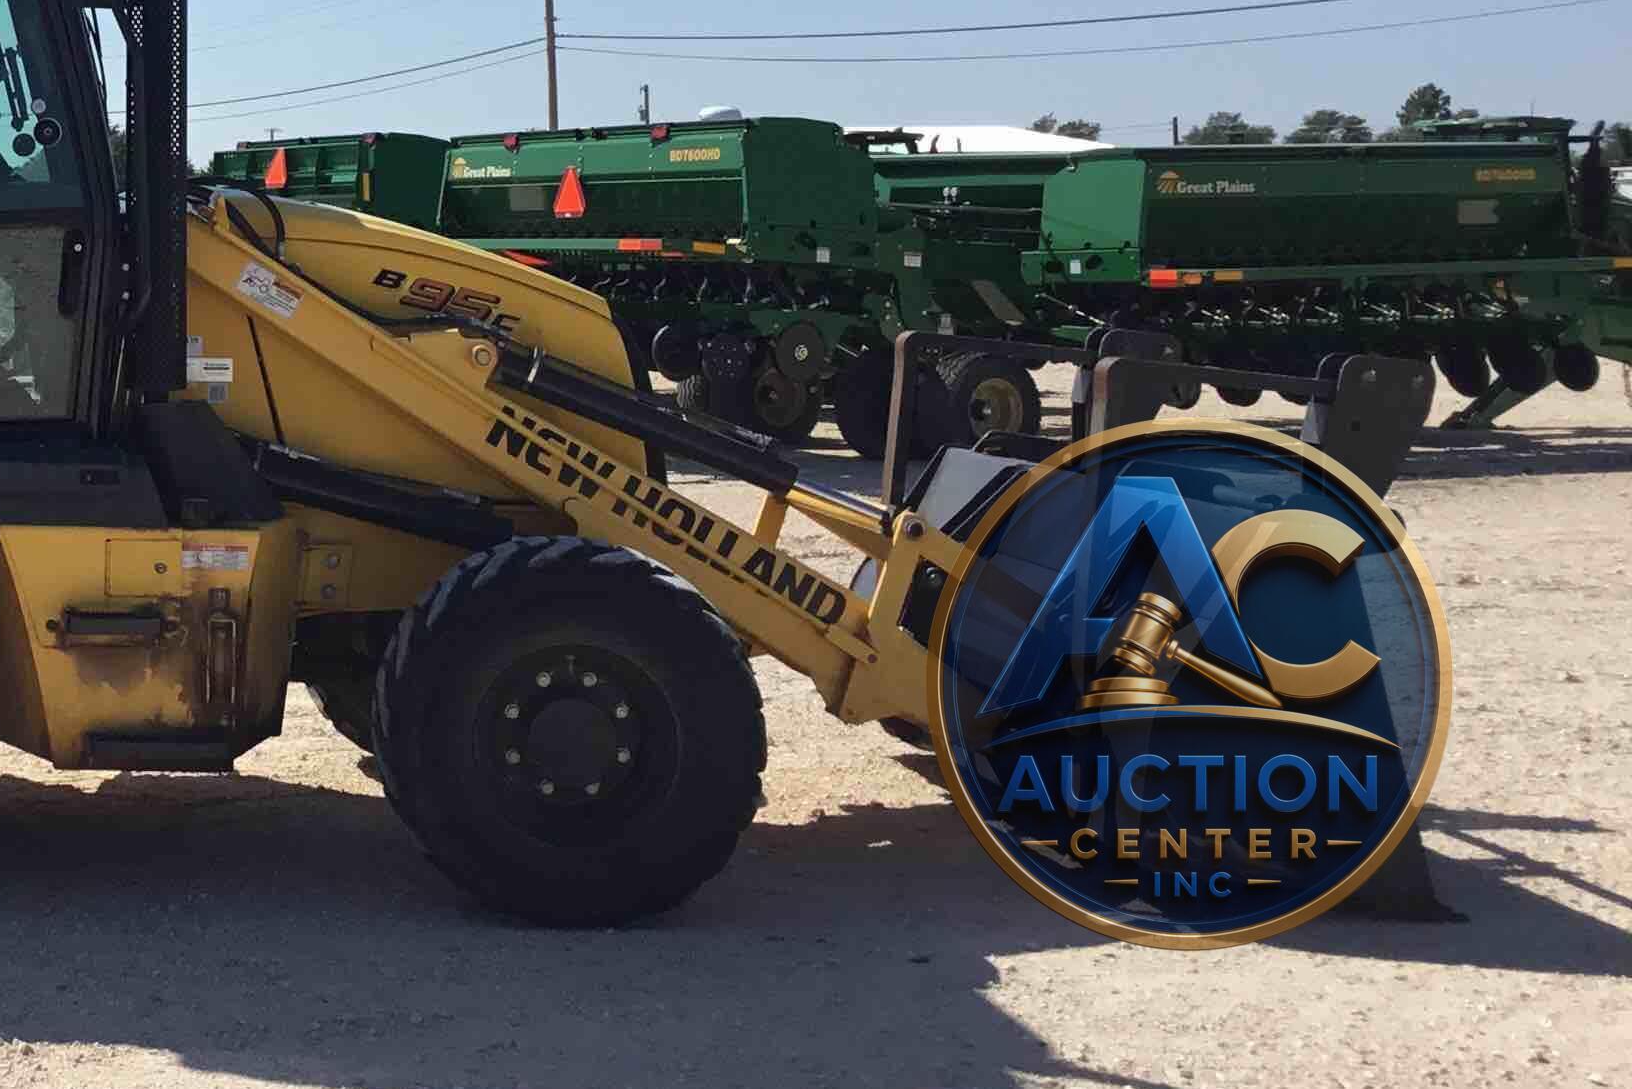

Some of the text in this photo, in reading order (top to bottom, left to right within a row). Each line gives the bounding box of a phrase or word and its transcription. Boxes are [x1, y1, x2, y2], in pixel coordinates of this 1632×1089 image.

[1176, 179, 1255, 193] Great Plains
[484, 404, 849, 626] NEW HOLLAND
